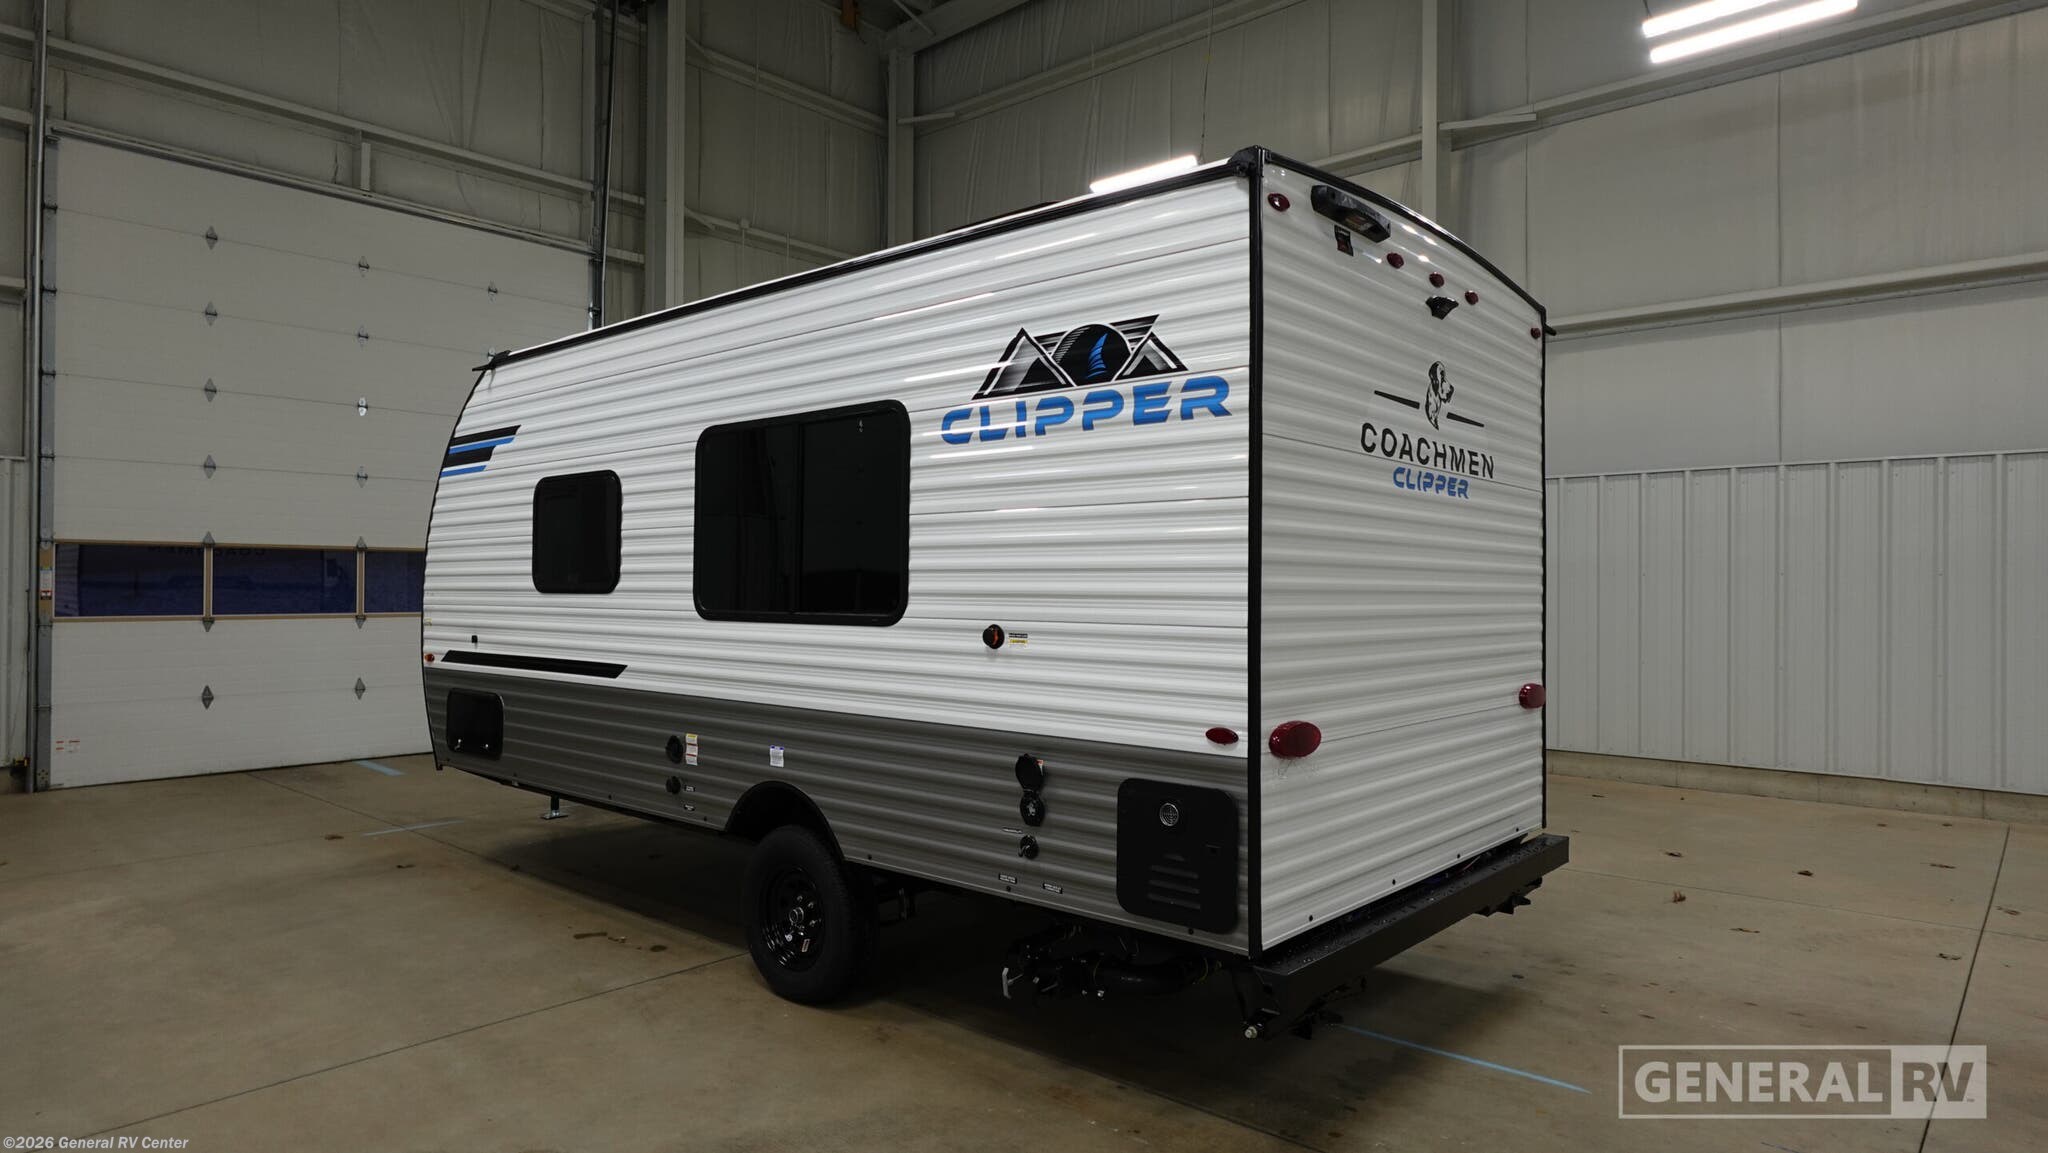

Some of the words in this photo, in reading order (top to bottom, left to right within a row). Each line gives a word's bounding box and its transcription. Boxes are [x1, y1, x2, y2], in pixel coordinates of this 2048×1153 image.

[941, 375, 1233, 445] CLIPPER
[1360, 422, 1494, 479] COACHMEN
[1393, 466, 1469, 499] CLIPPER
